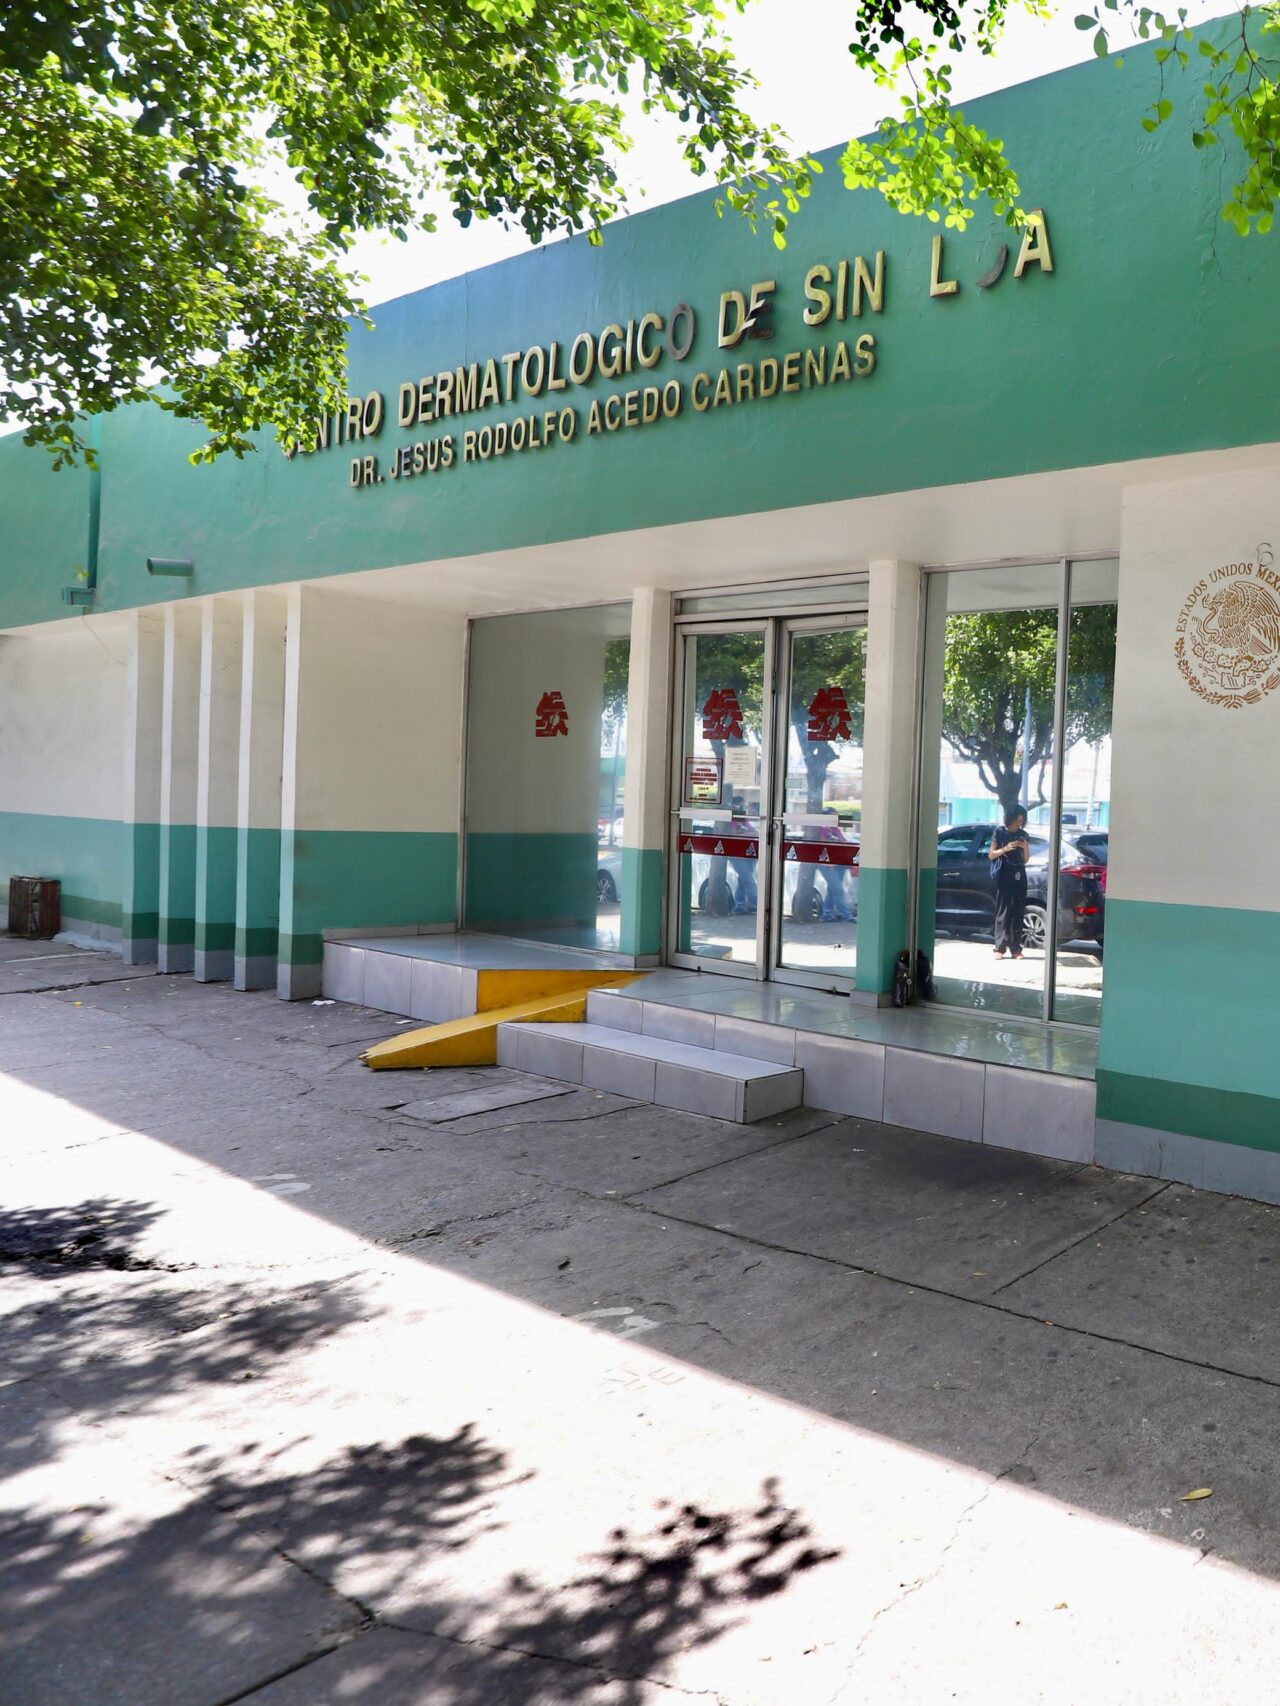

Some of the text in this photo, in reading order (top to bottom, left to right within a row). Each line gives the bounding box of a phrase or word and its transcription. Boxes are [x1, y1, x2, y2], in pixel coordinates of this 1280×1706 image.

[350, 334, 876, 488] DR. JESUS RODOLFO ACEDO CARDENAS
[399, 303, 695, 427] DERMATOLOGICO
[718, 280, 776, 349] DE
[1176, 580, 1208, 633] ESTADOS
[1209, 562, 1253, 583] UNIDOS
